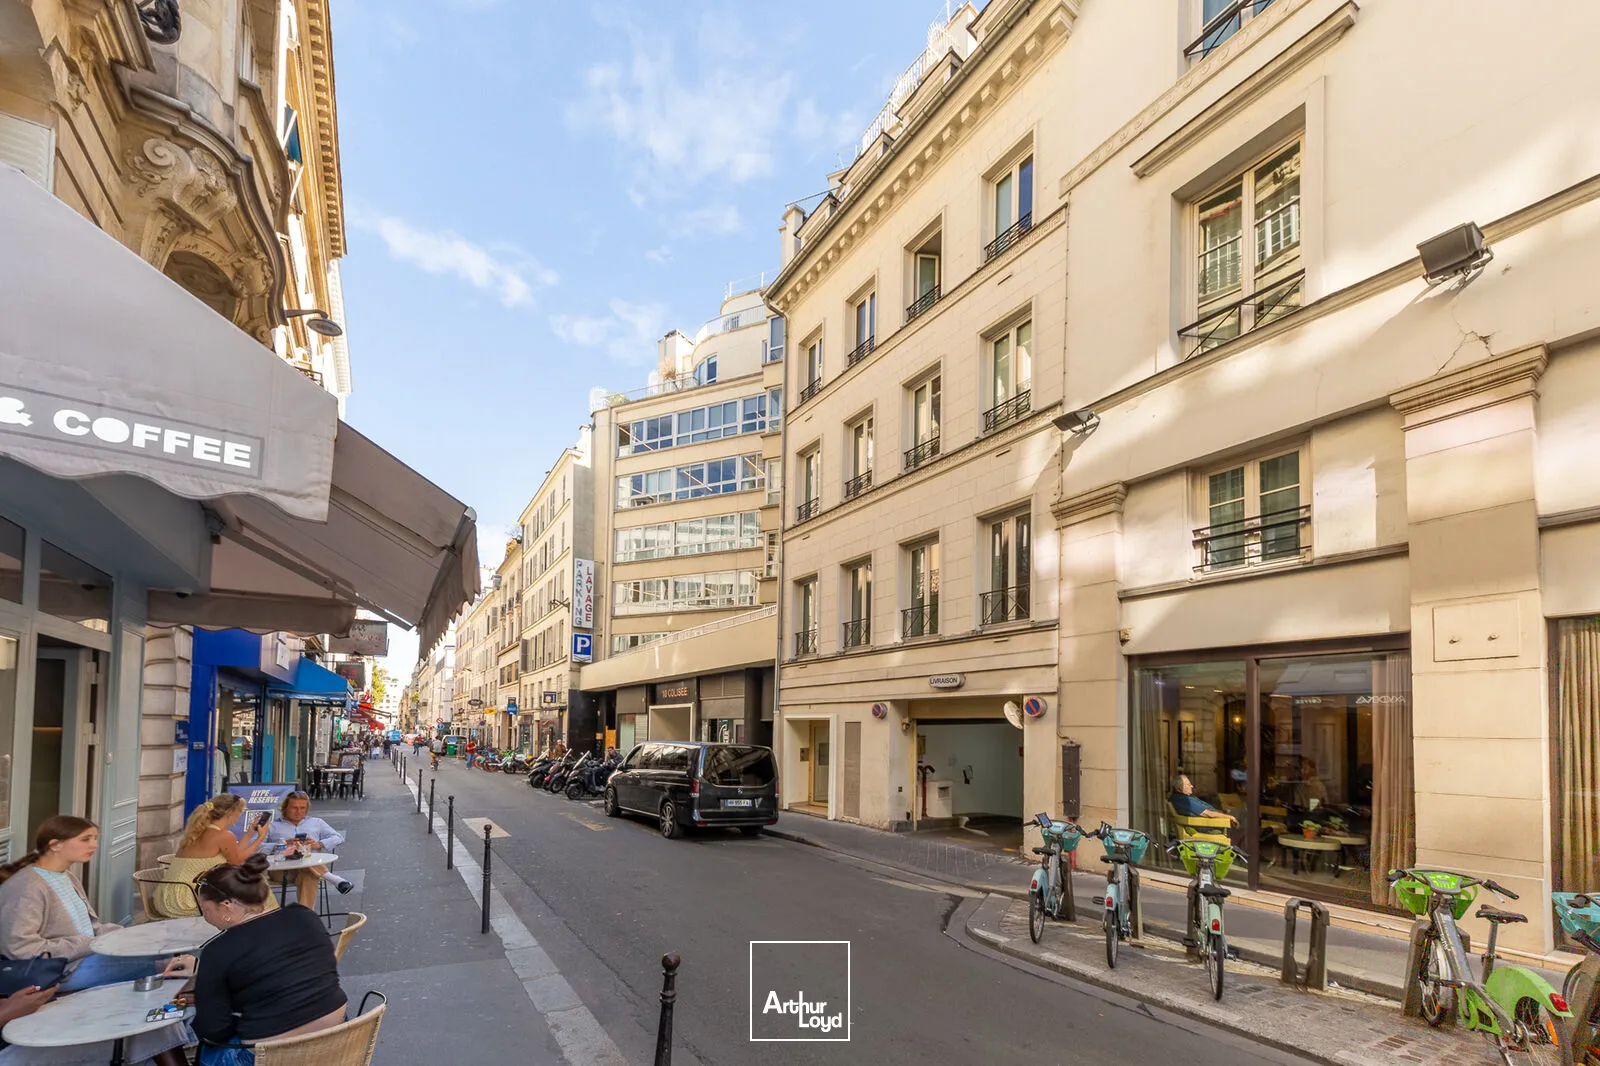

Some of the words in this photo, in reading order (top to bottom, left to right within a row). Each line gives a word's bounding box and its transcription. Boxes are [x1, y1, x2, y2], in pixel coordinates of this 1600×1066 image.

[0, 397, 33, 427] &
[53, 409, 252, 469] COFFEE
[585, 566, 593, 622] LAVAGE
[576, 636, 590, 653] P
